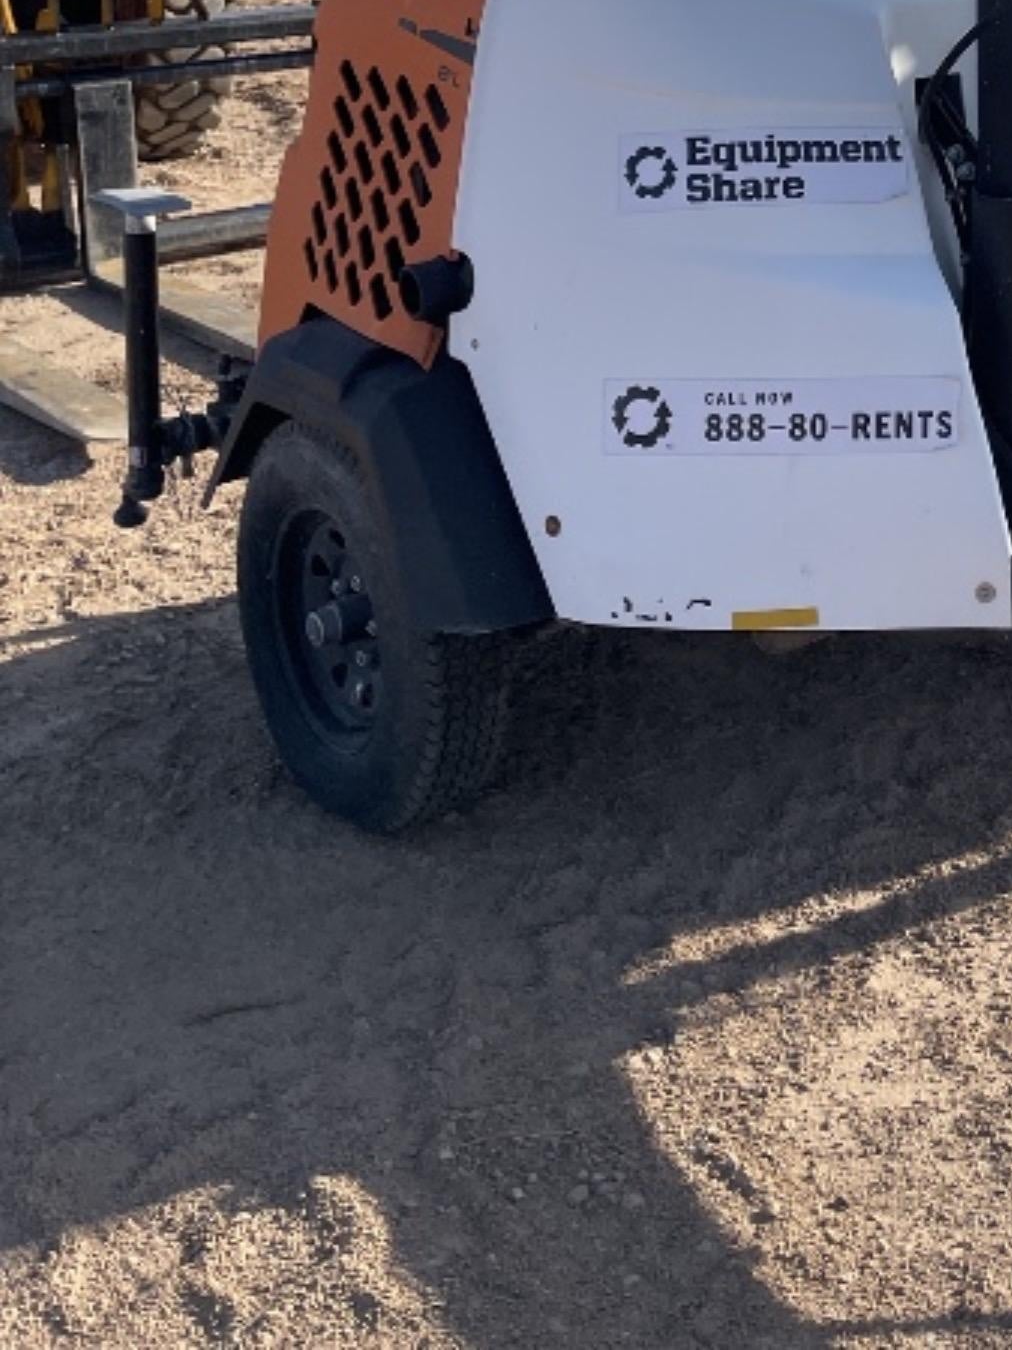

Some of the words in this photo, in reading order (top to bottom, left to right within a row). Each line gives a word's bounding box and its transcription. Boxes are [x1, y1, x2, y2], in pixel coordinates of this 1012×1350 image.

[685, 135, 903, 171] Equipment
[686, 173, 805, 202] Share
[704, 391, 748, 406] CALL
[755, 391, 793, 406] NOW
[703, 410, 952, 442] 888-80-RENTS
